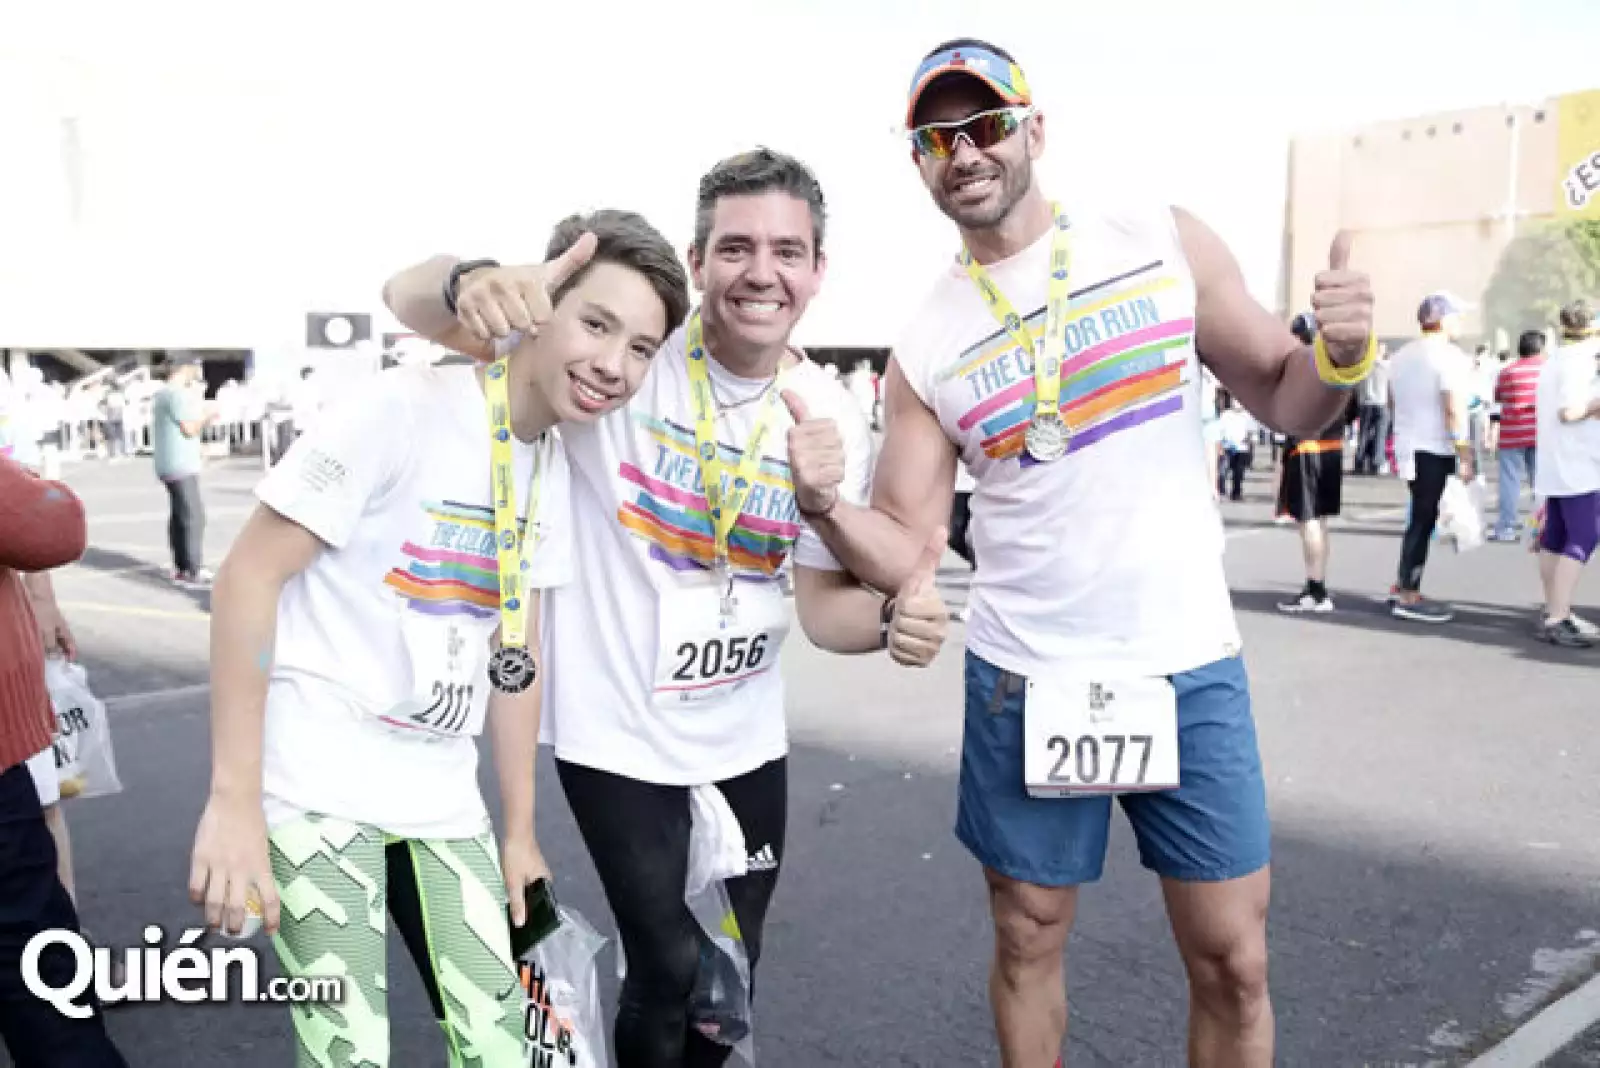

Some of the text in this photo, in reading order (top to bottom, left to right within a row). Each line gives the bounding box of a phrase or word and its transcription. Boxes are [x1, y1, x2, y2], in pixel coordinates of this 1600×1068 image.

[965, 350, 1016, 401] THE
[1099, 296, 1161, 338] RUN
[672, 632, 768, 681] 2056
[1047, 735, 1153, 784] 2077
